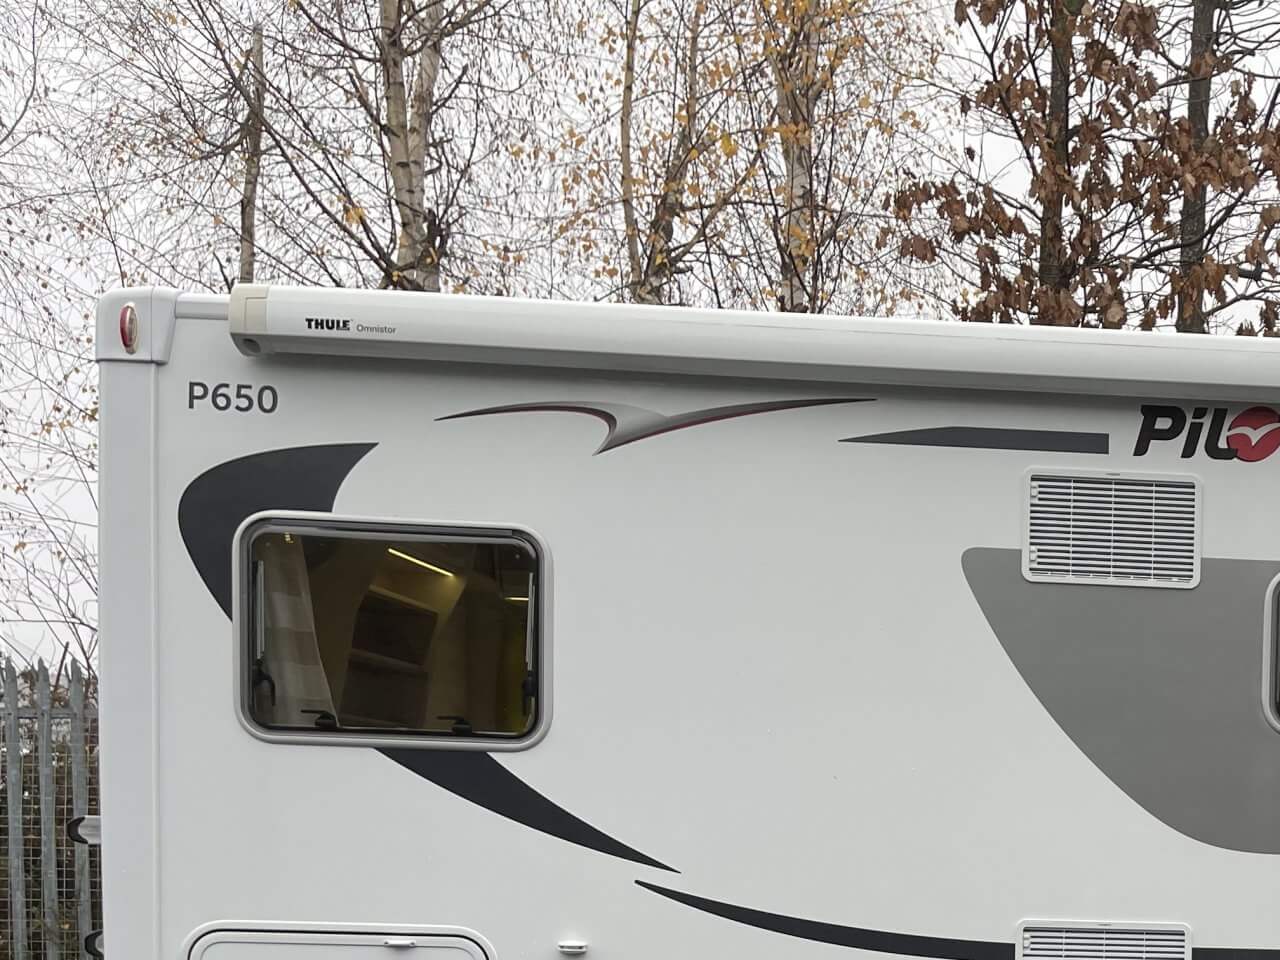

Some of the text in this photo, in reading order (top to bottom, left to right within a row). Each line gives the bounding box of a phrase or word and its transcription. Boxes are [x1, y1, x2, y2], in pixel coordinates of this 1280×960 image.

[305, 318, 397, 334] THULE Omnistor
[188, 381, 279, 414] P650
